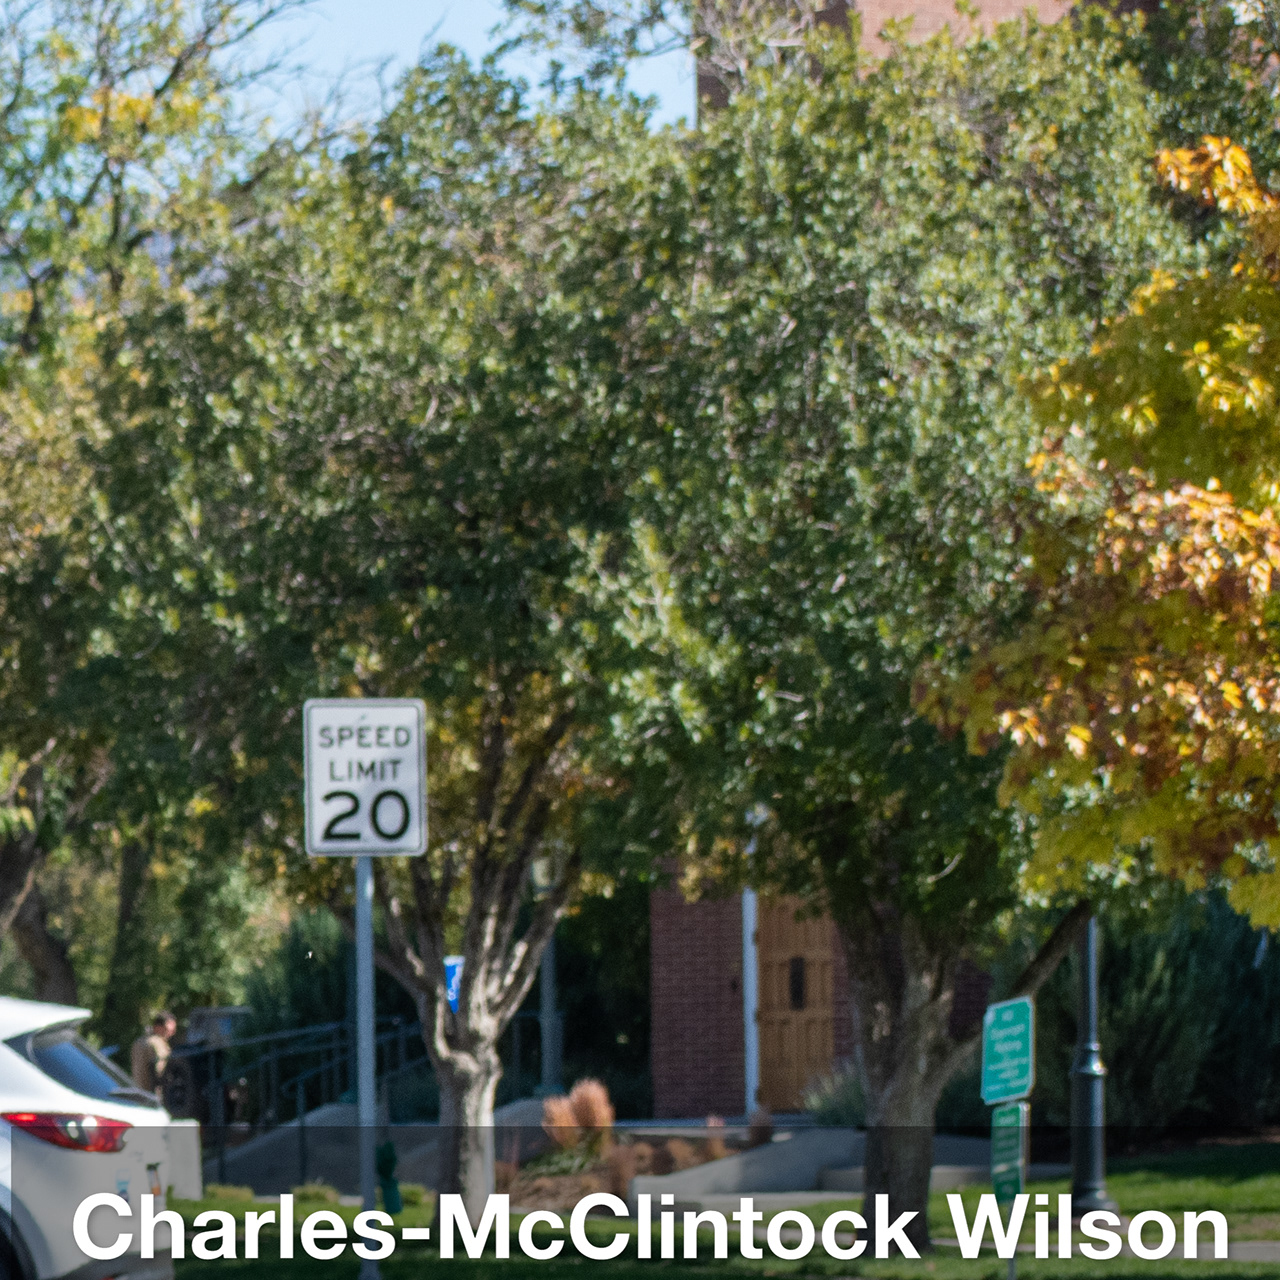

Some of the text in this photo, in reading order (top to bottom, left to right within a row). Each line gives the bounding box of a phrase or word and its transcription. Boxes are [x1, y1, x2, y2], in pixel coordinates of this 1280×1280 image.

[319, 726, 412, 748] SPEED
[329, 759, 402, 781] LIMIT
[322, 789, 410, 840] 20
